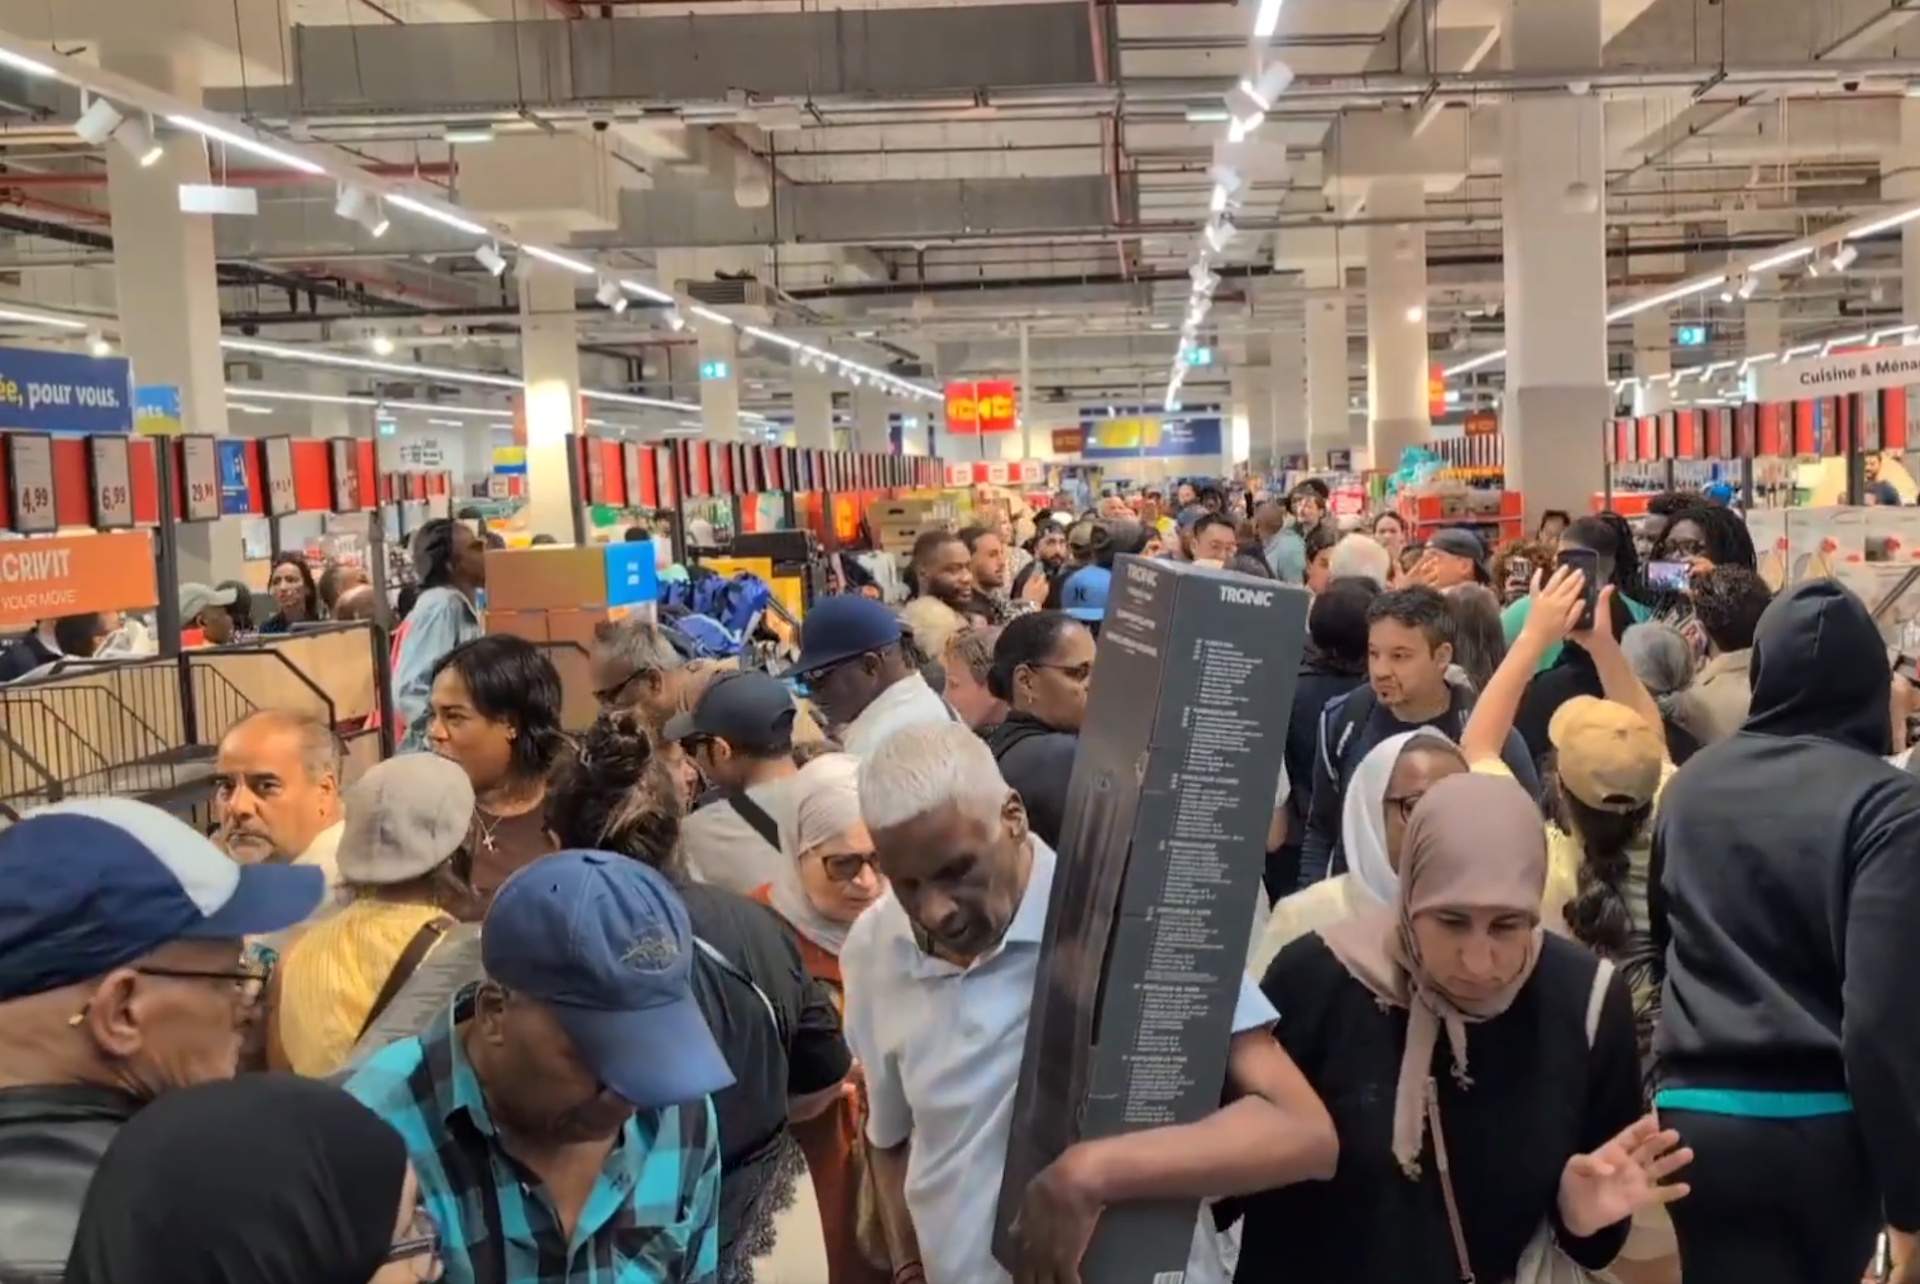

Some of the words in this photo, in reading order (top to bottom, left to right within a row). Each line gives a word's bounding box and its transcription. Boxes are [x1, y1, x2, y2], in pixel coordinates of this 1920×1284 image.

[1800, 364, 1856, 385] Cuisine
[1861, 362, 1871, 376] &
[1876, 358, 1920, 375] Ména
[28, 382, 71, 410] pour
[76, 386, 120, 408] vous.
[3, 549, 71, 582] CRIVIT
[39, 589, 78, 607] MOVE
[1219, 585, 1274, 607] TRONIC
